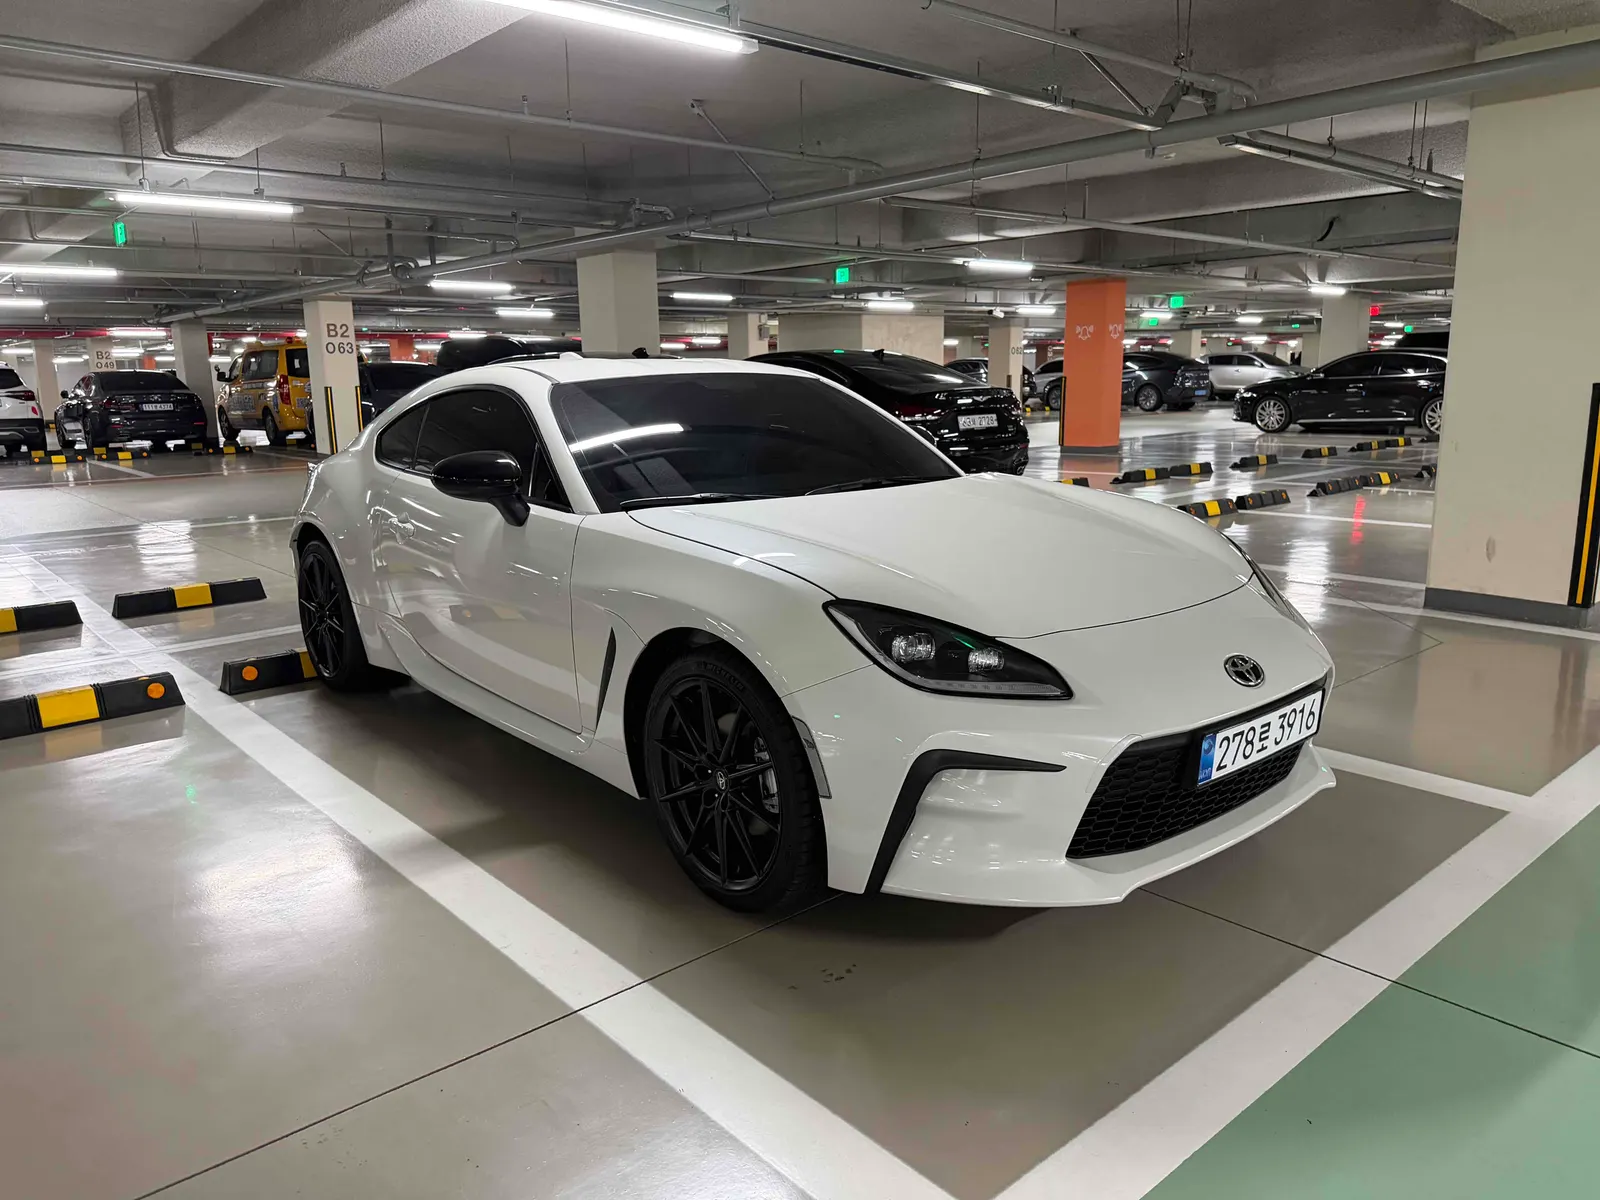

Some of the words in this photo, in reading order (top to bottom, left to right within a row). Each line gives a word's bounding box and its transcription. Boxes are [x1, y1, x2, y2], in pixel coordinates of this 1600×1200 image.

[326, 323, 350, 338] B2
[96, 350, 111, 360] B2
[1215, 721, 1271, 772] 278로
[1274, 698, 1316, 746] 3916
